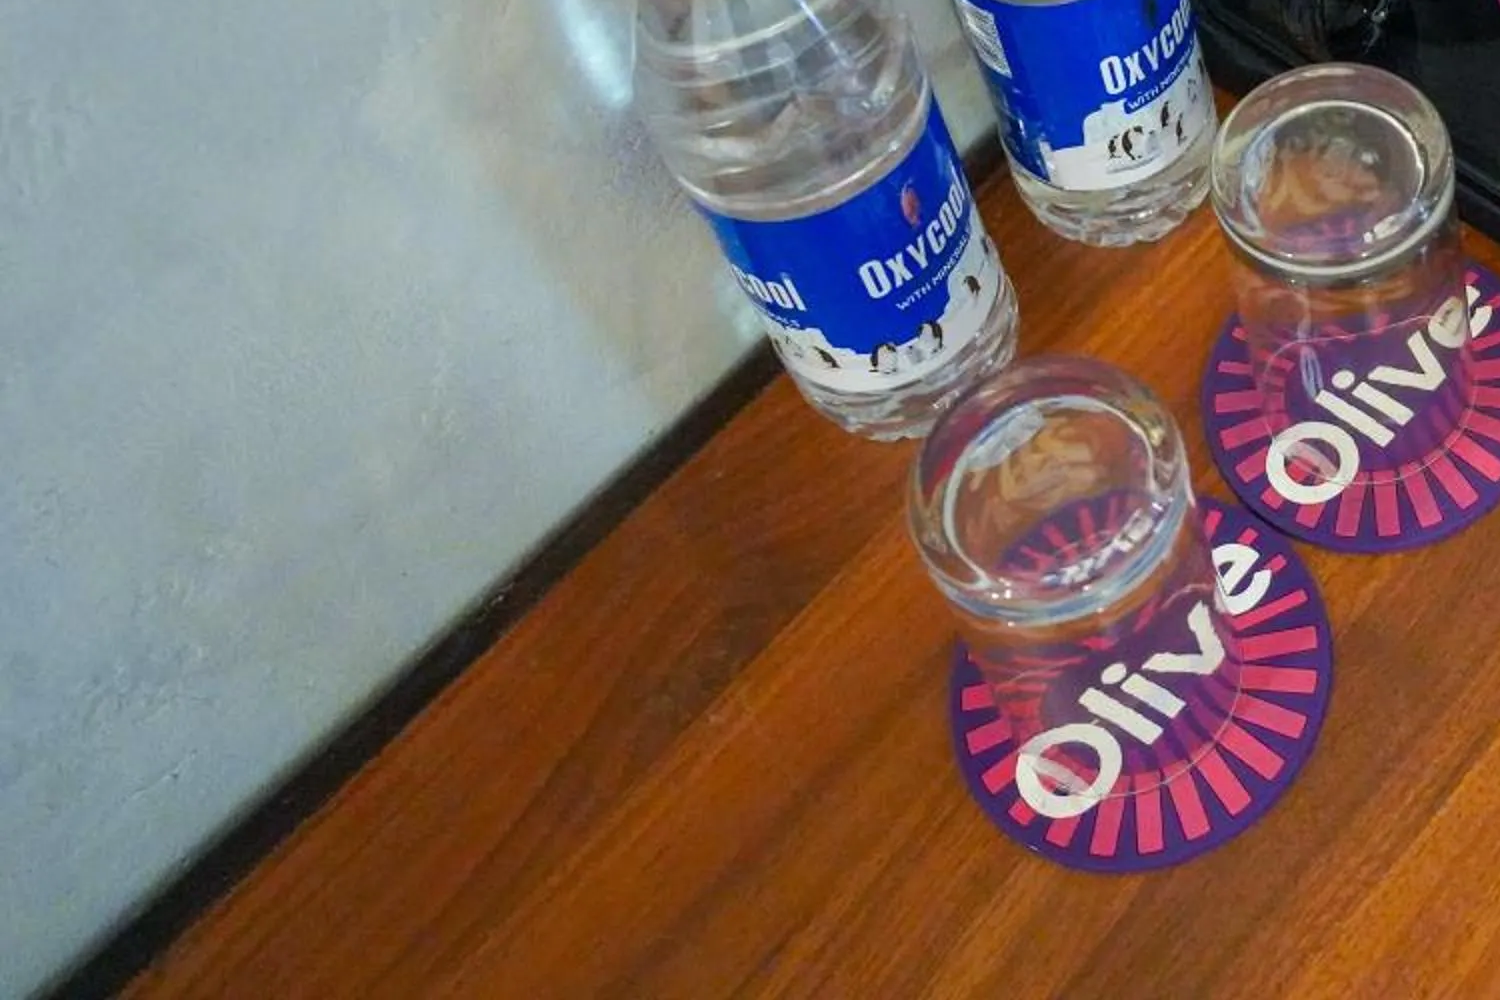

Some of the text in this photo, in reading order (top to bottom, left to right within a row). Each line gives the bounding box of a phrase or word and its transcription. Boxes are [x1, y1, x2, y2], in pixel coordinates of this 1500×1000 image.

[895, 282, 932, 311] WITH
[1265, 285, 1493, 505] Olive
[1014, 542, 1273, 820] Olive
